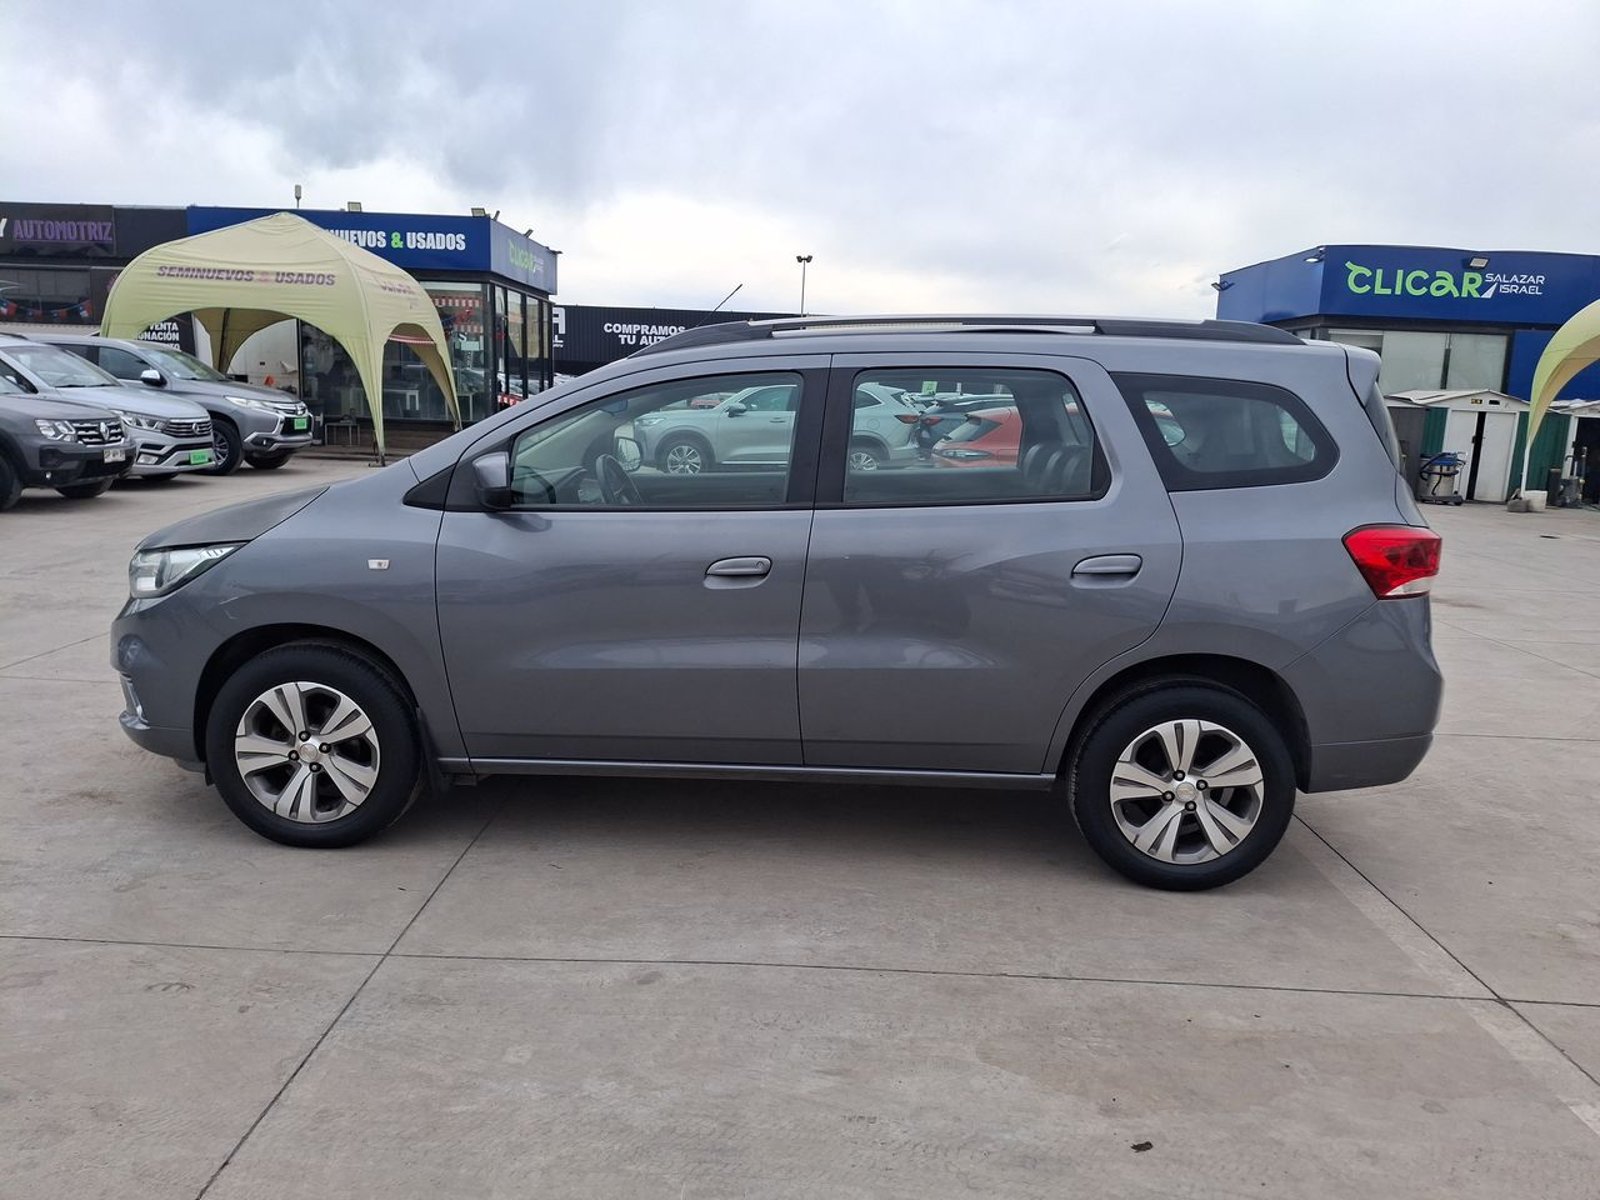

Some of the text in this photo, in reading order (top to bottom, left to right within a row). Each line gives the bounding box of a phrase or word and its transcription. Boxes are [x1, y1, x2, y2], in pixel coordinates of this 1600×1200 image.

[14, 220, 112, 241] AUTOMOTRIZ
[391, 232, 403, 248] &
[406, 232, 466, 250] USADOS
[157, 265, 254, 282] SEMINUEVOS
[275, 271, 336, 286] USADOS
[1485, 273, 1545, 285] SALAZAR
[1500, 284, 1543, 295] ISRAEL
[603, 322, 686, 336] COMPRAMOS
[618, 334, 636, 345] TU
